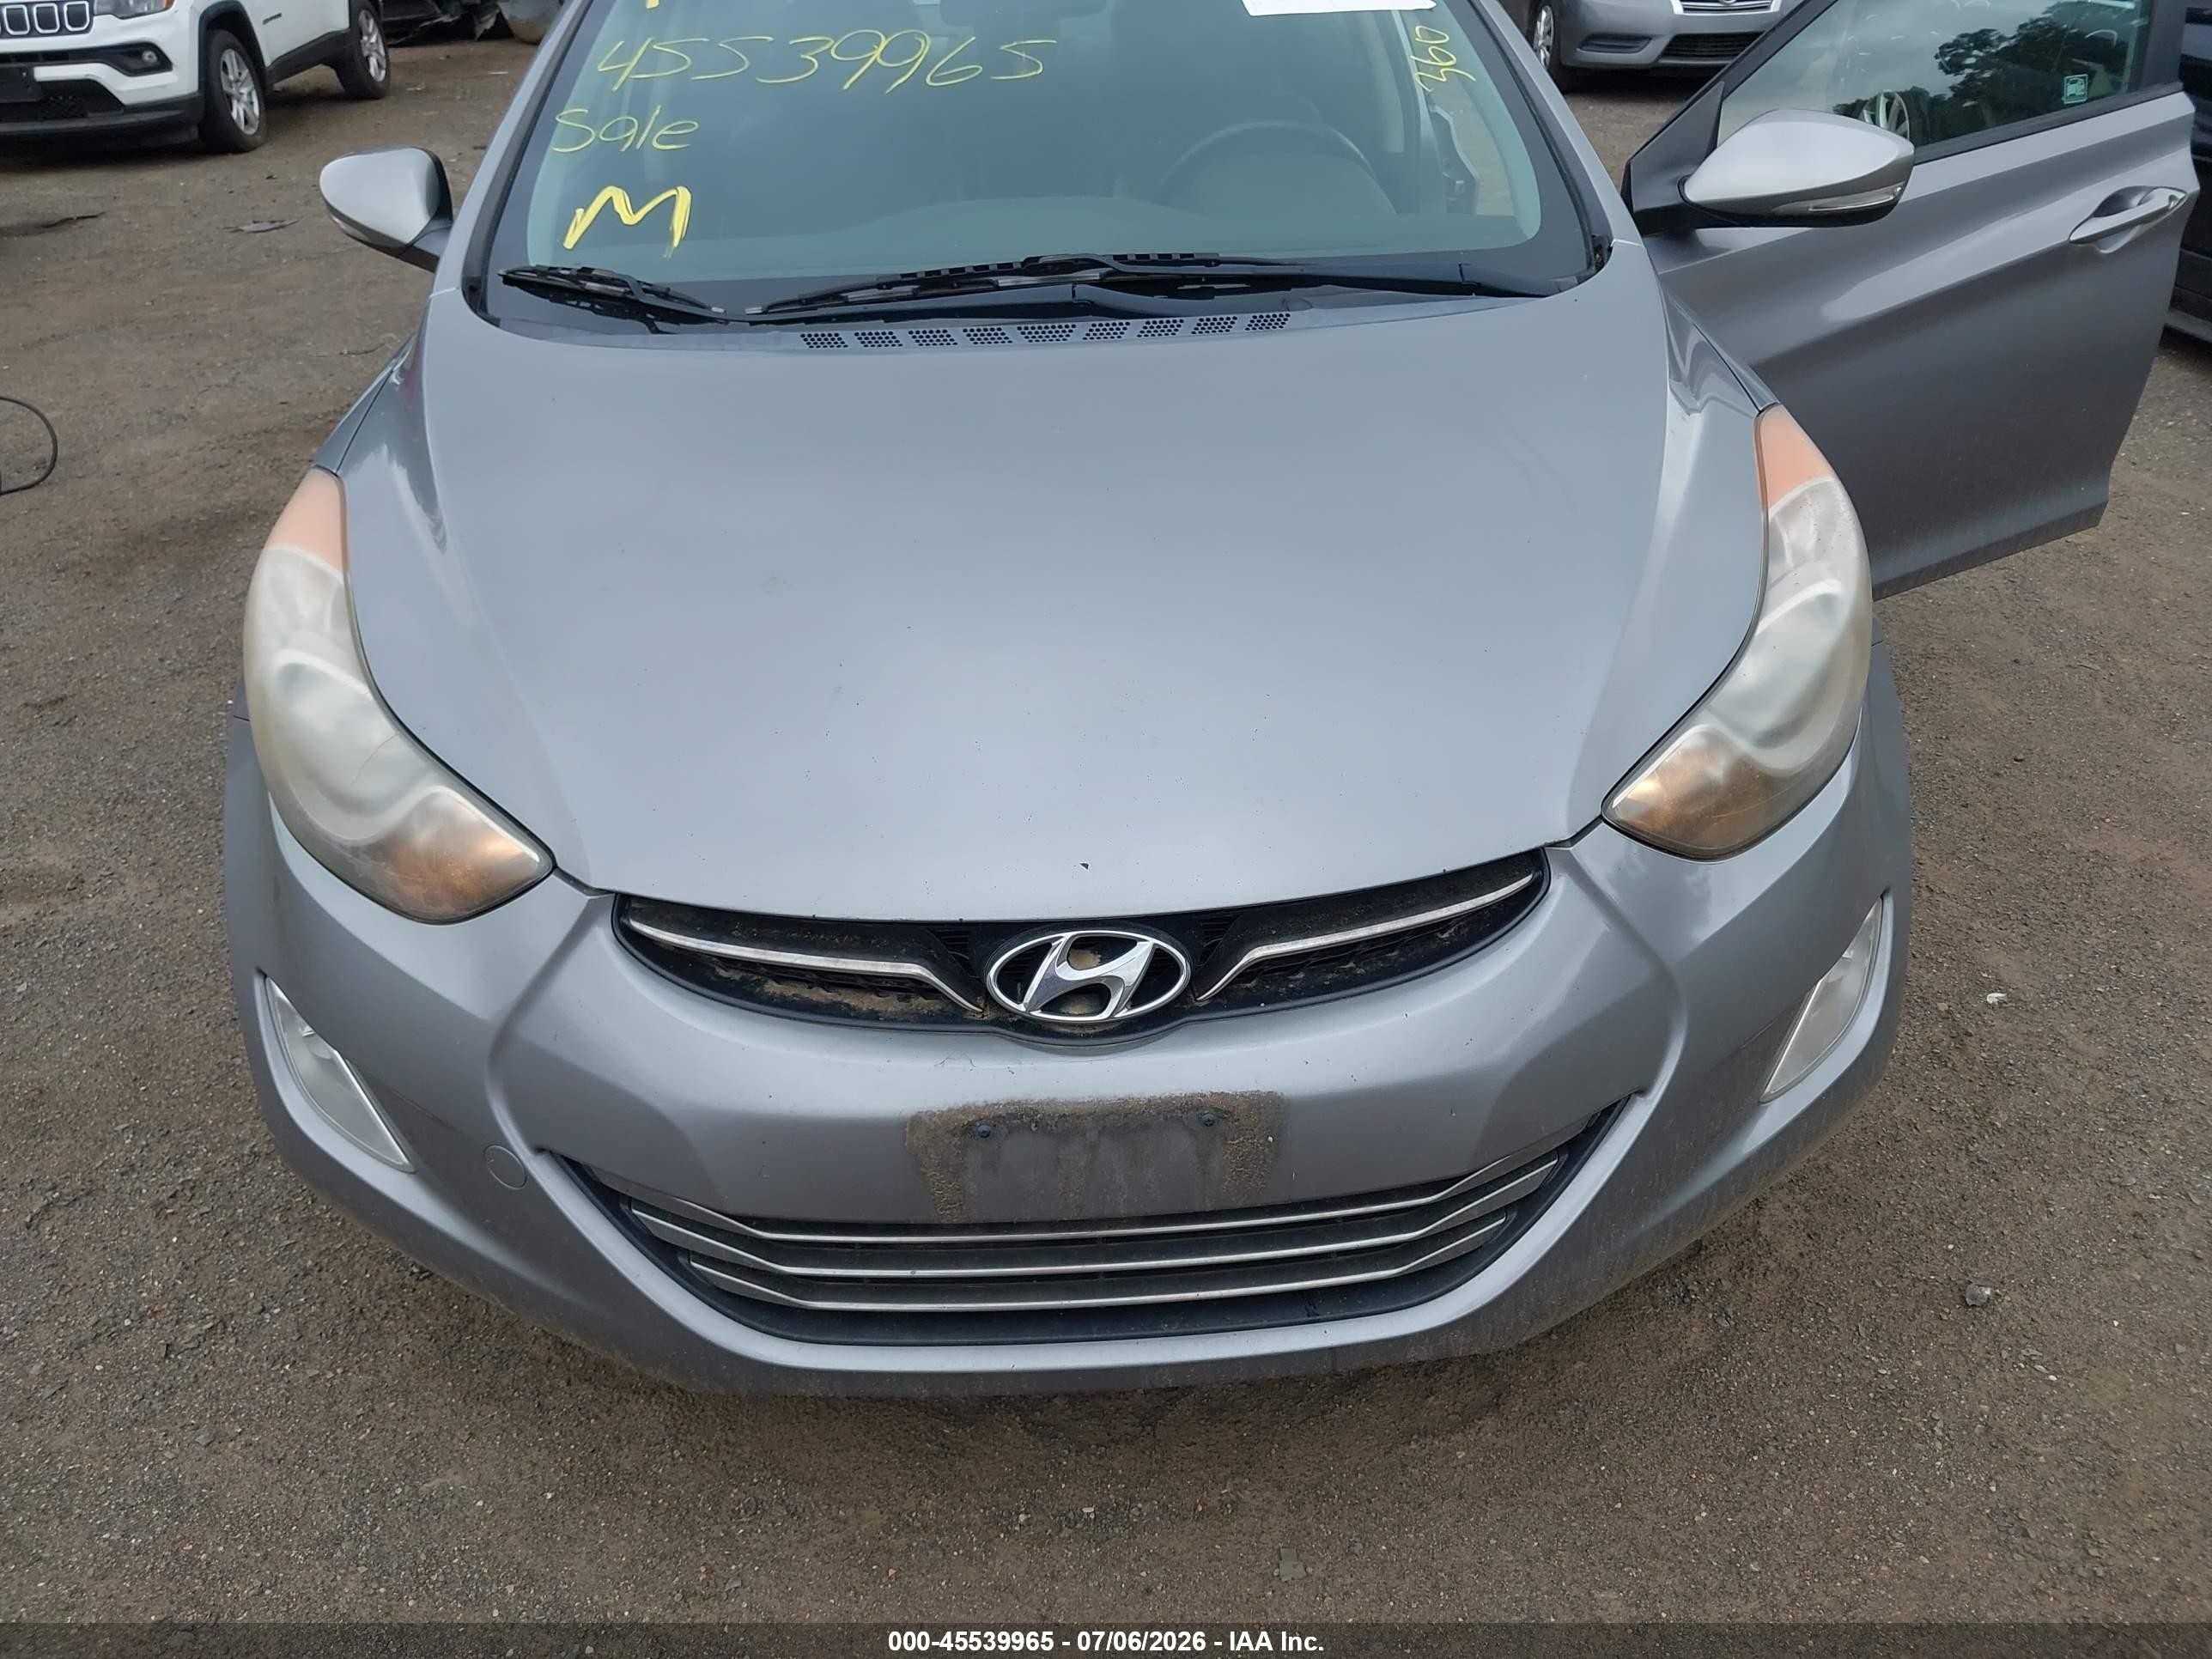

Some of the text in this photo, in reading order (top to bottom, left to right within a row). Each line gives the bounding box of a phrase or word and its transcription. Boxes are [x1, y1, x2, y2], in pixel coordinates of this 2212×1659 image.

[597, 29, 1058, 94] 45539965
[1409, 25, 1477, 93] 360
[562, 185, 692, 258] M
